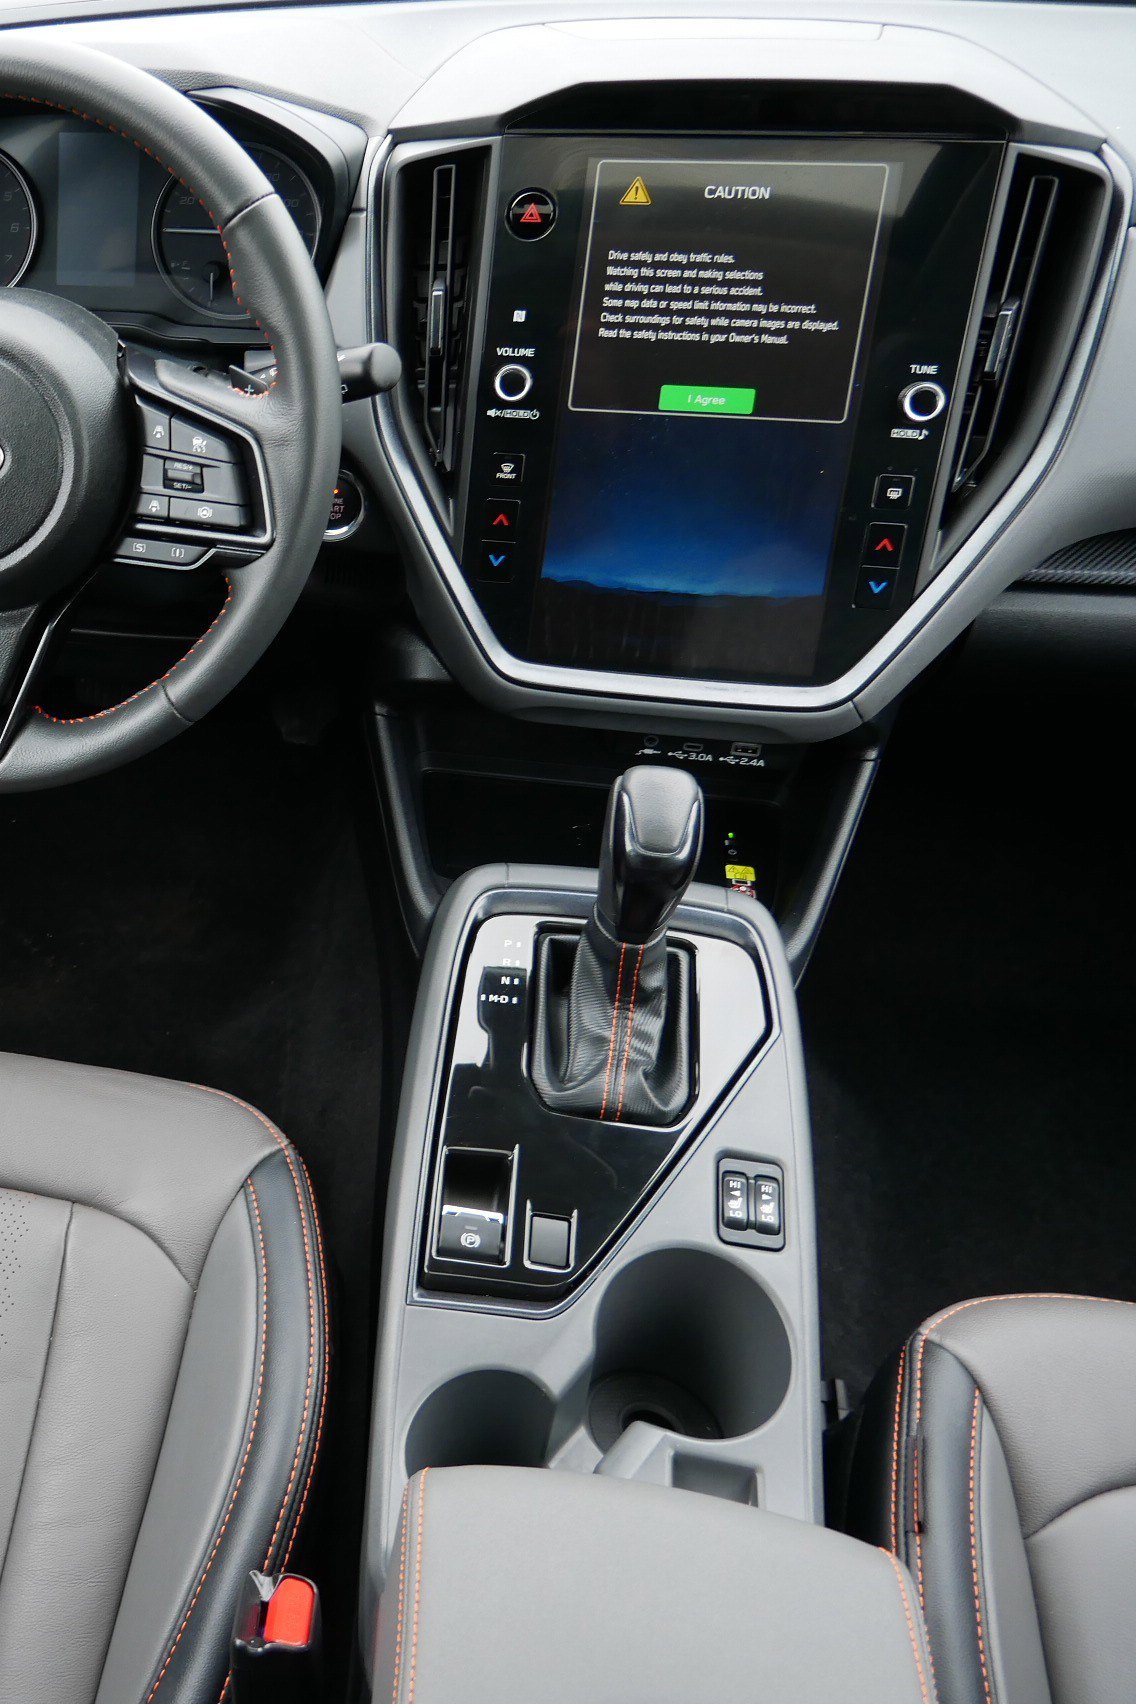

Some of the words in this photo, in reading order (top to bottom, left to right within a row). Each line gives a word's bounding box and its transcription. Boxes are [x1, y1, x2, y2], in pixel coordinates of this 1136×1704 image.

[704, 185, 771, 200] CAUTION
[608, 250, 628, 260] Drive
[630, 251, 653, 263] safely
[654, 252, 668, 261] and
[669, 252, 688, 264] obey
[689, 253, 713, 263] traffic
[714, 253, 735, 263] rules.
[606, 266, 639, 278] Watching
[640, 267, 654, 277] this
[656, 268, 681, 278] screen
[683, 268, 697, 278] and
[698, 269, 724, 281] making
[724, 269, 763, 280] selections
[604, 282, 623, 291] while
[624, 282, 649, 294] driving
[650, 284, 664, 293] can
[665, 283, 682, 293] lead
[683, 284, 692, 293] to
[693, 286, 699, 294] a
[700, 285, 728, 295] serious
[729, 285, 763, 295] accident.
[602, 297, 623, 307] Some
[624, 299, 640, 309] map
[640, 298, 658, 308] data
[659, 300, 668, 308] or
[669, 299, 693, 310] speed
[693, 299, 710, 310] limit
[710, 300, 751, 311] information
[751, 303, 768, 314] may
[768, 303, 779, 312] be
[780, 303, 817, 313] incorrect.
[600, 312, 623, 322] Check
[624, 314, 671, 326] surroundings
[672, 315, 684, 325] for
[685, 315, 709, 328] safety
[710, 317, 730, 326] while
[730, 319, 758, 328] camera
[759, 318, 785, 330] images
[786, 320, 801, 329] are
[801, 320, 839, 332] displayed.
[598, 327, 618, 337] Read
[619, 328, 632, 338] the
[632, 329, 657, 341] safety
[657, 330, 700, 341] instructions
[701, 332, 709, 341] in
[709, 333, 728, 343] your
[729, 332, 759, 343] Owner's
[760, 333, 789, 344] Manual.
[496, 346, 536, 357] VOLUME
[909, 364, 939, 375] TUNE
[694, 394, 726, 406] Agree
[890, 428, 920, 440] HOLD
[496, 472, 517, 480] FRONT
[688, 752, 713, 762] 3.0A
[739, 757, 766, 768] 2.4A
[504, 939, 513, 948] P
[502, 958, 511, 966] R
[500, 976, 510, 985] N
[729, 1180, 741, 1189] HI
[760, 1185, 773, 1194] HI
[729, 1210, 743, 1218] LO
[761, 1214, 775, 1223] LO
